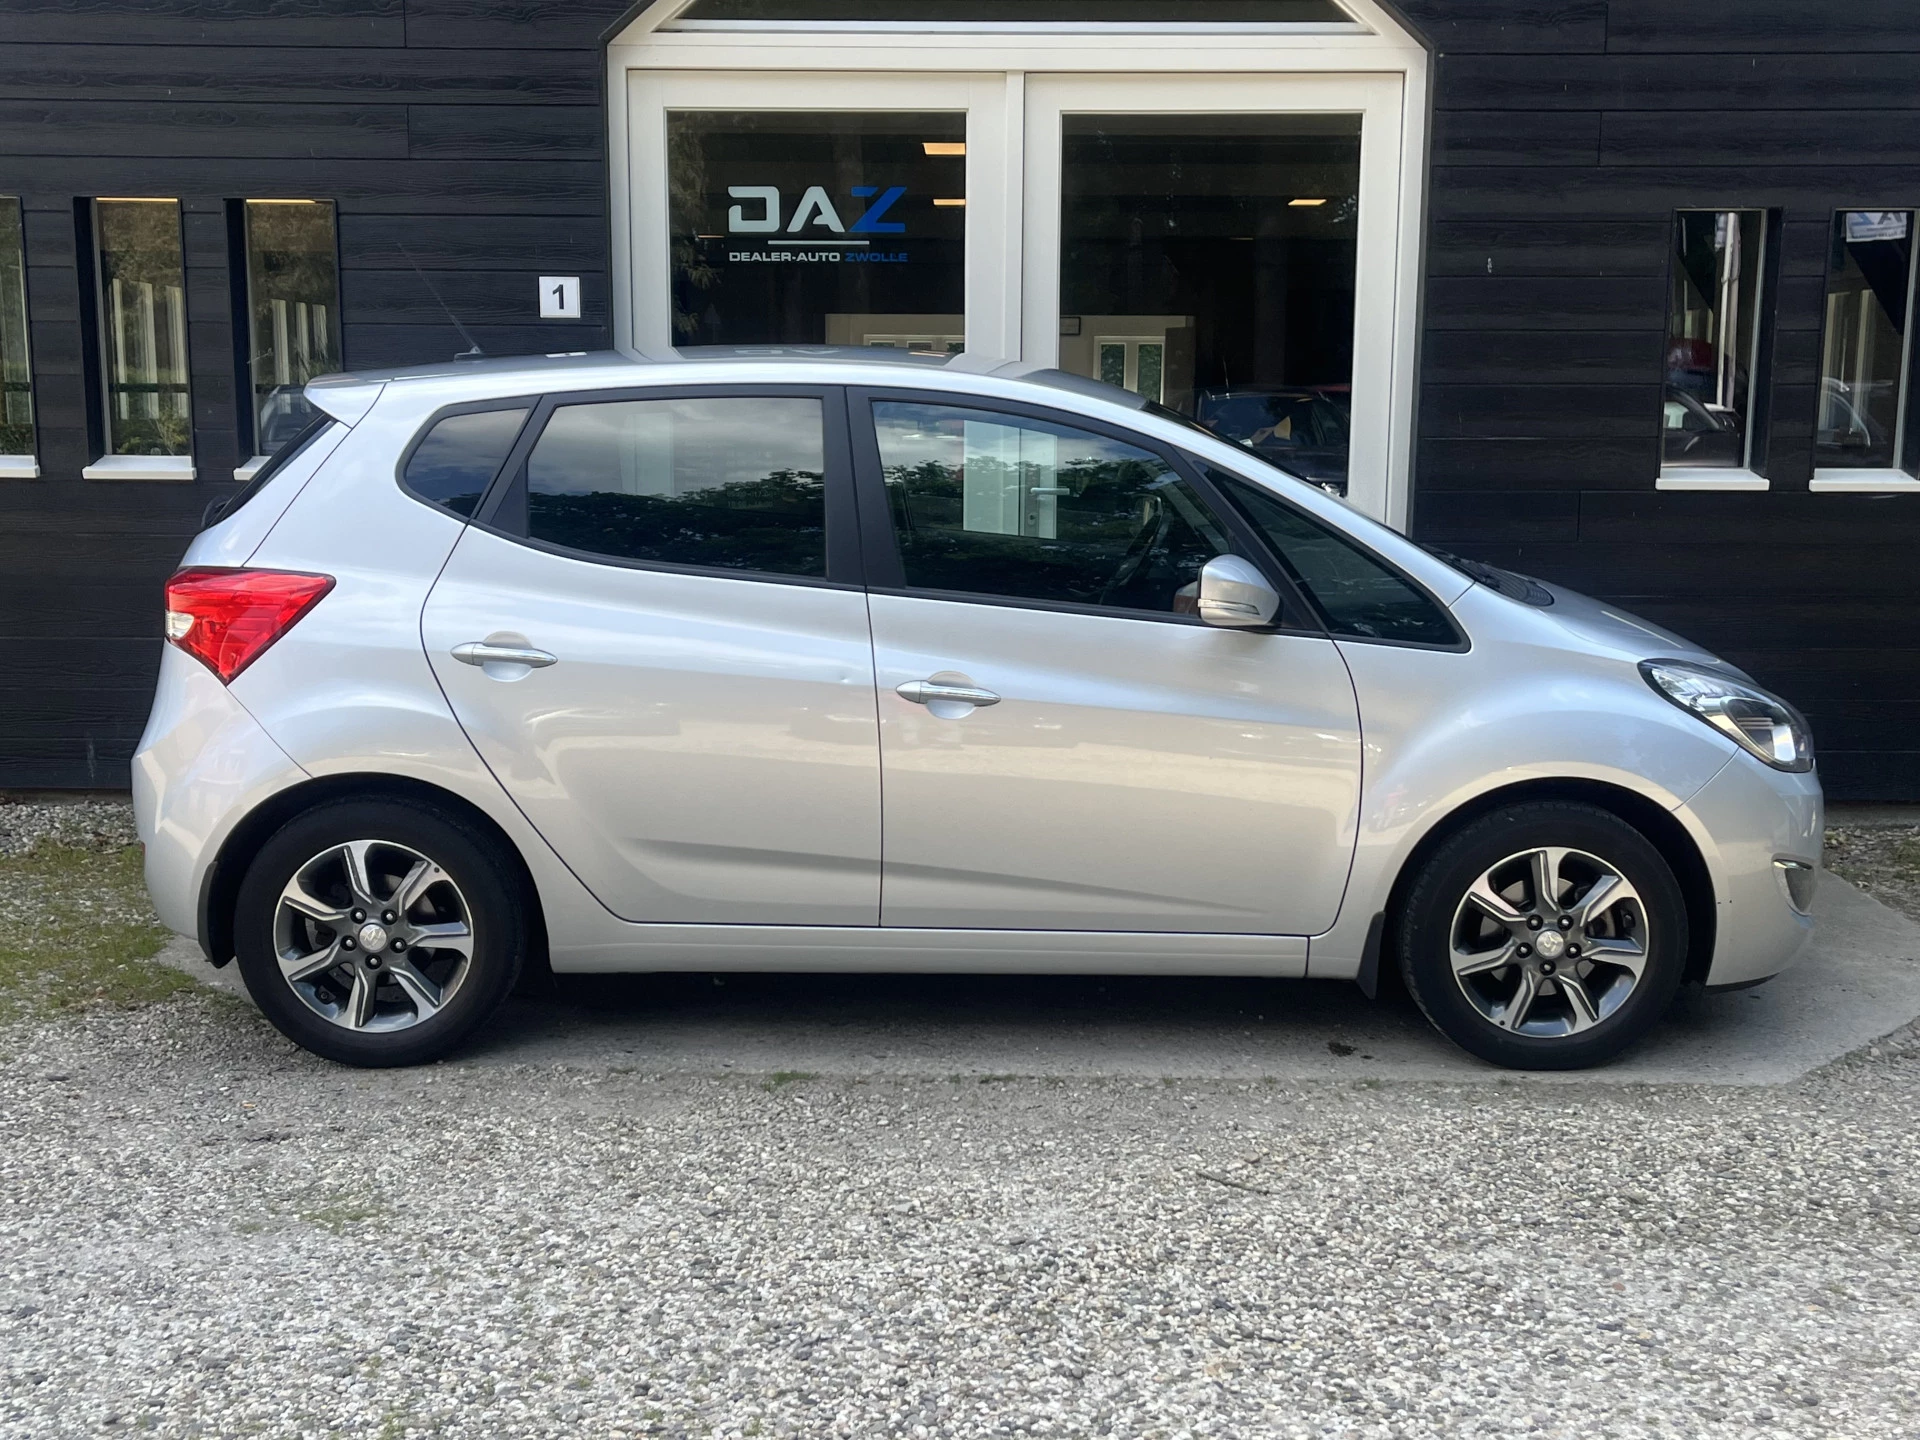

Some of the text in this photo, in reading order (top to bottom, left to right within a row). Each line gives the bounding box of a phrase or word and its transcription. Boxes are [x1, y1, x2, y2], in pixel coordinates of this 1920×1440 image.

[727, 185, 908, 233] DAZ
[728, 251, 909, 263] DEALER-AUTO ZWOLLE
[552, 283, 565, 310] 1
